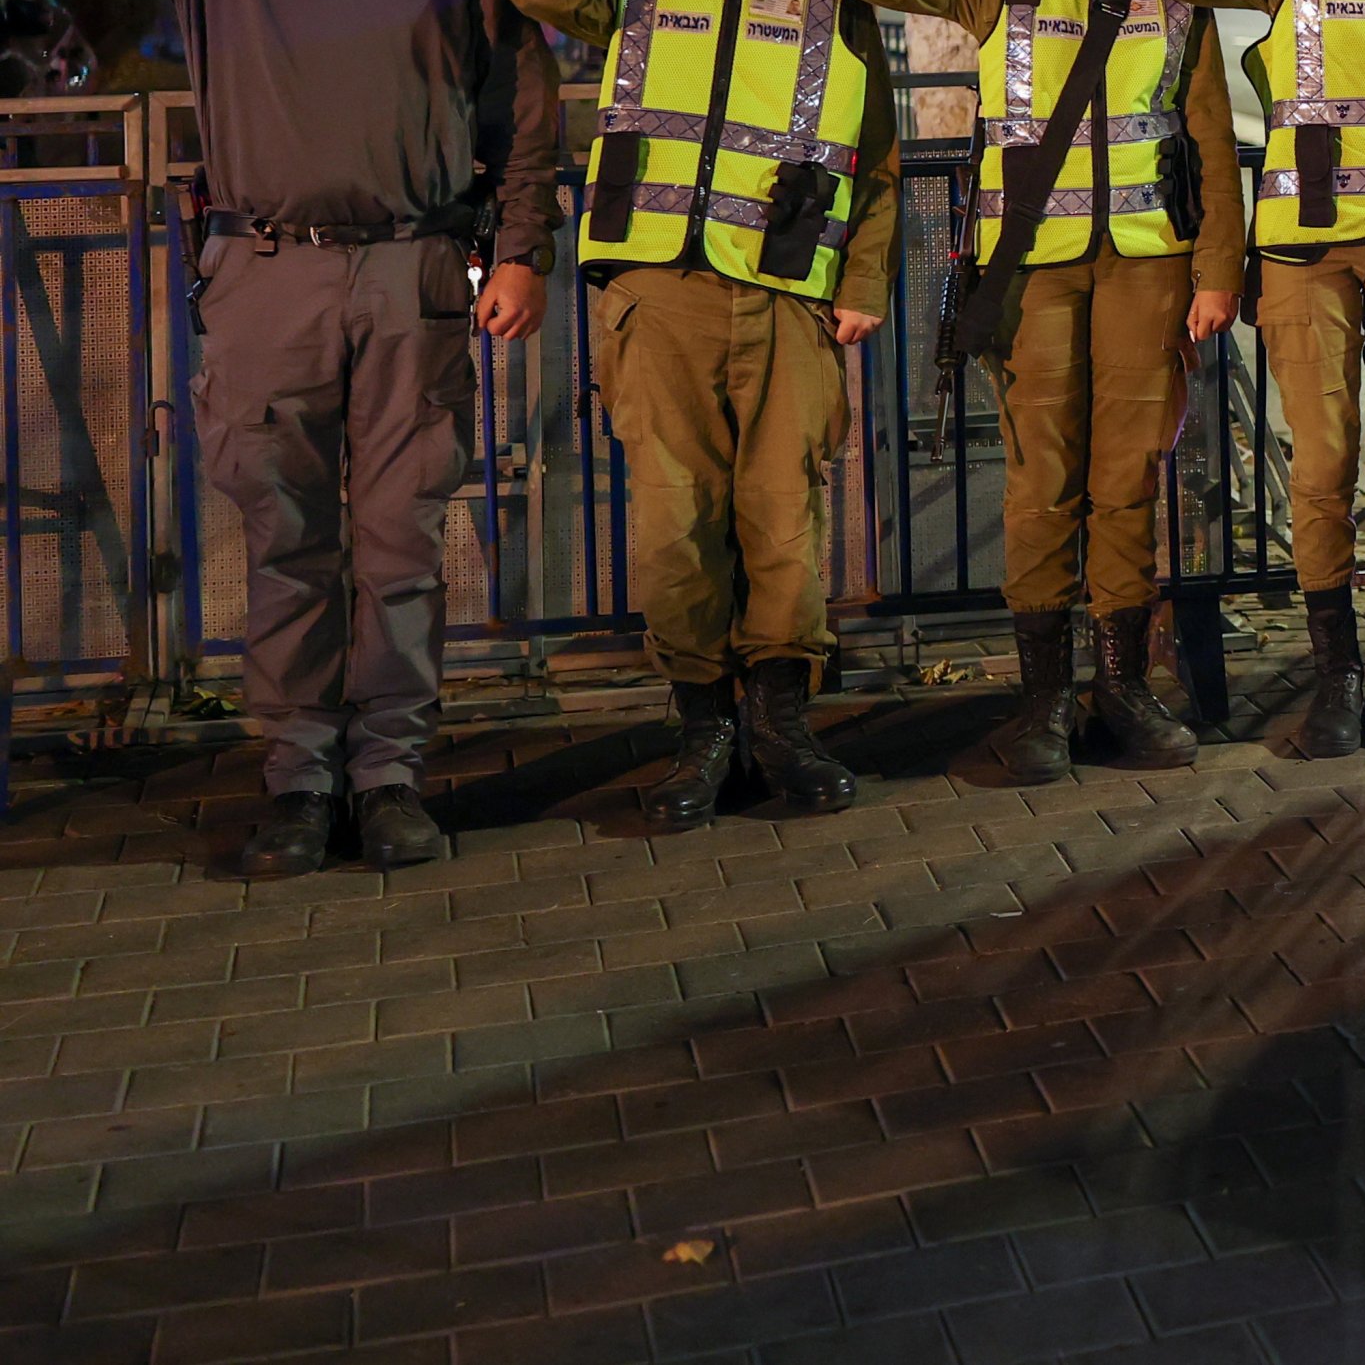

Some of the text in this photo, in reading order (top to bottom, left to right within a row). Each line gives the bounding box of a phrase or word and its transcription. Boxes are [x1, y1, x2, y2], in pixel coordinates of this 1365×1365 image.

[657, 12, 799, 43] המשטרה הצבאית
[1037, 18, 1160, 36] המשטר הצבאית
